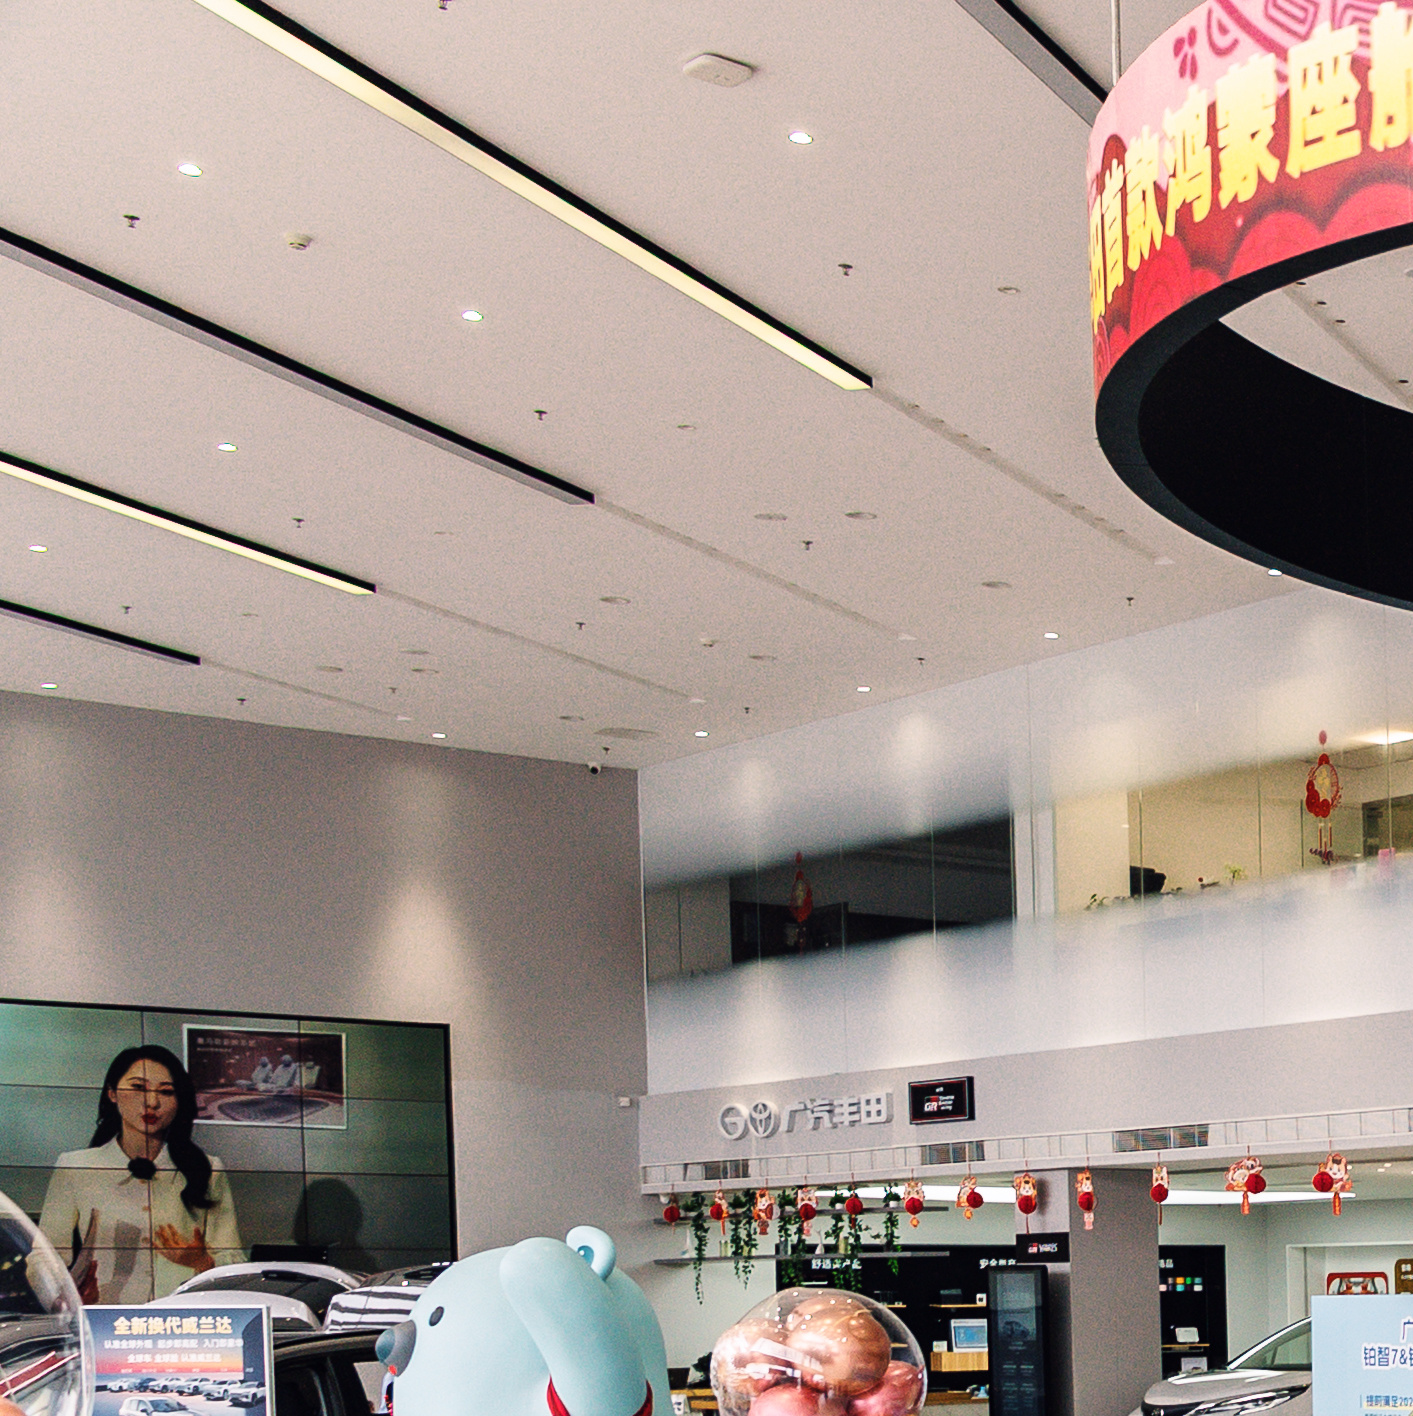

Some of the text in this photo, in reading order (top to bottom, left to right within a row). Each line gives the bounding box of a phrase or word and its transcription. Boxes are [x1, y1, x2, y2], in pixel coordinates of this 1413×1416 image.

[780, 1092, 891, 1133] 广汽丰田
[113, 1316, 233, 1336] 全新换代威兰达
